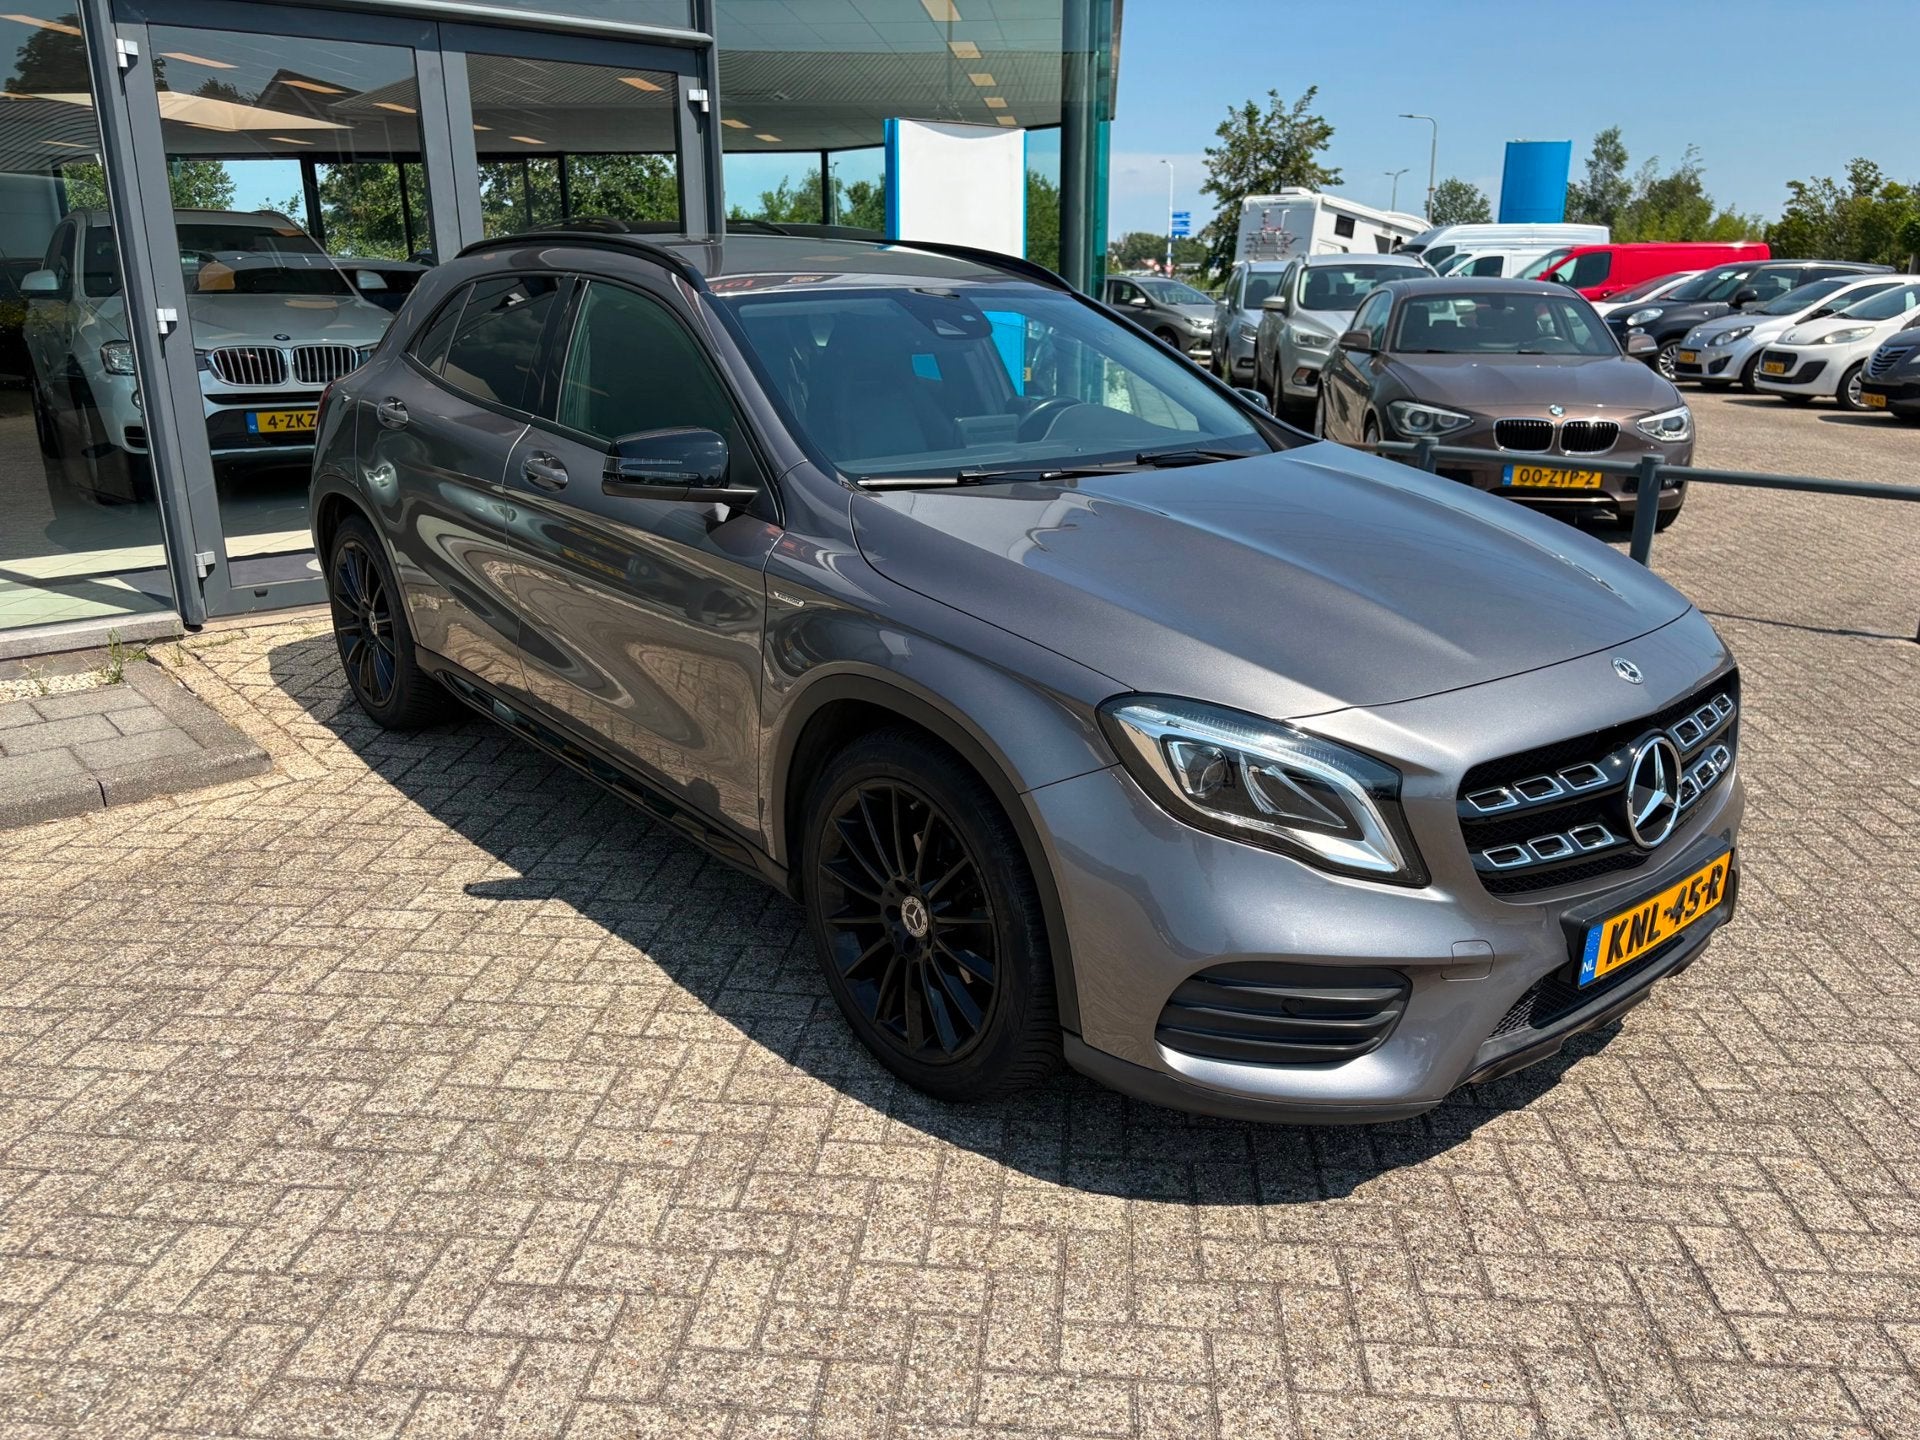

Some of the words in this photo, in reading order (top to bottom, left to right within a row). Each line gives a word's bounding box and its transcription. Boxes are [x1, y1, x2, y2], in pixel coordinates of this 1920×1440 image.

[1519, 468, 1595, 485] 00-ZTP-2
[1582, 959, 1595, 974] NL
[1606, 864, 1724, 965] KNL-45-R
